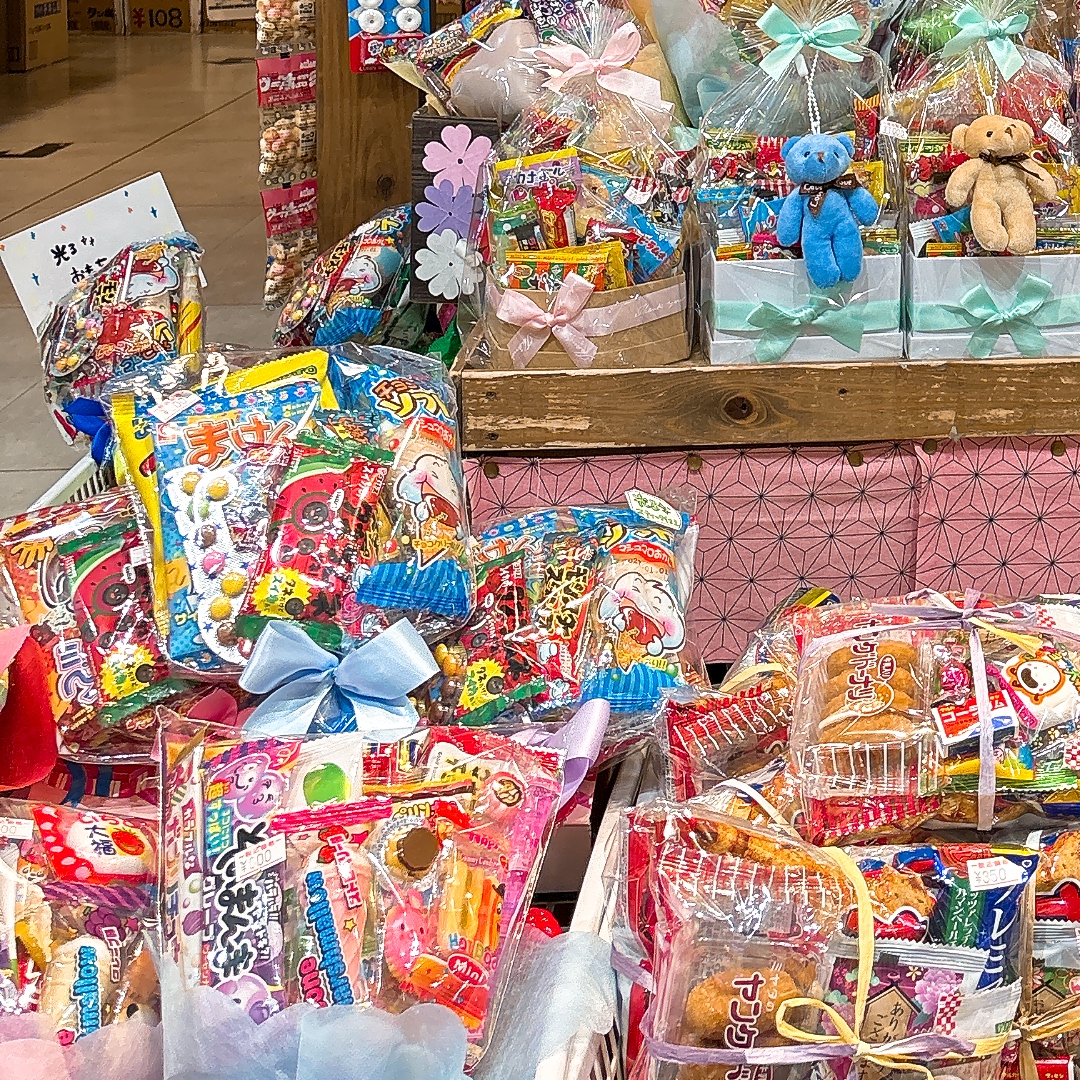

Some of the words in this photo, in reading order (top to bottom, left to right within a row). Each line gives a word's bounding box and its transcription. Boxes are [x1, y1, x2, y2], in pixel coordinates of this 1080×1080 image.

[184, 412, 294, 470] まけん
[973, 866, 1006, 883] ¥350
[452, 959, 487, 984] Mini
